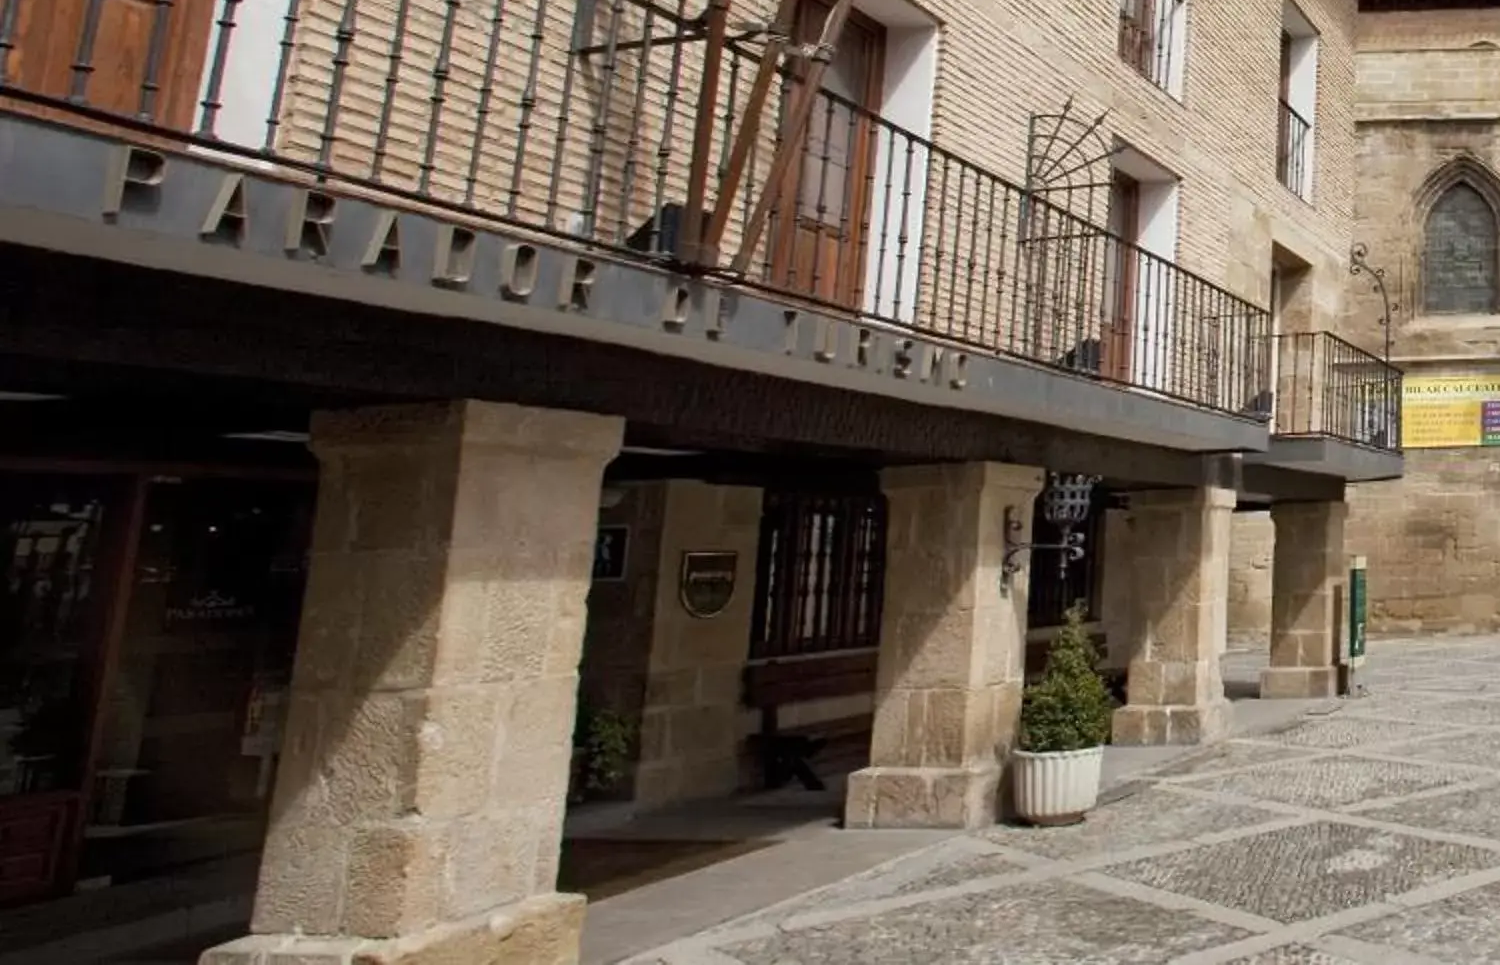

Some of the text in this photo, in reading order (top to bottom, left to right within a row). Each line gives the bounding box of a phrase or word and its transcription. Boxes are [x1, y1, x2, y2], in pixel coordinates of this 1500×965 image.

[101, 145, 968, 389] PARADOR DE TURISMO
